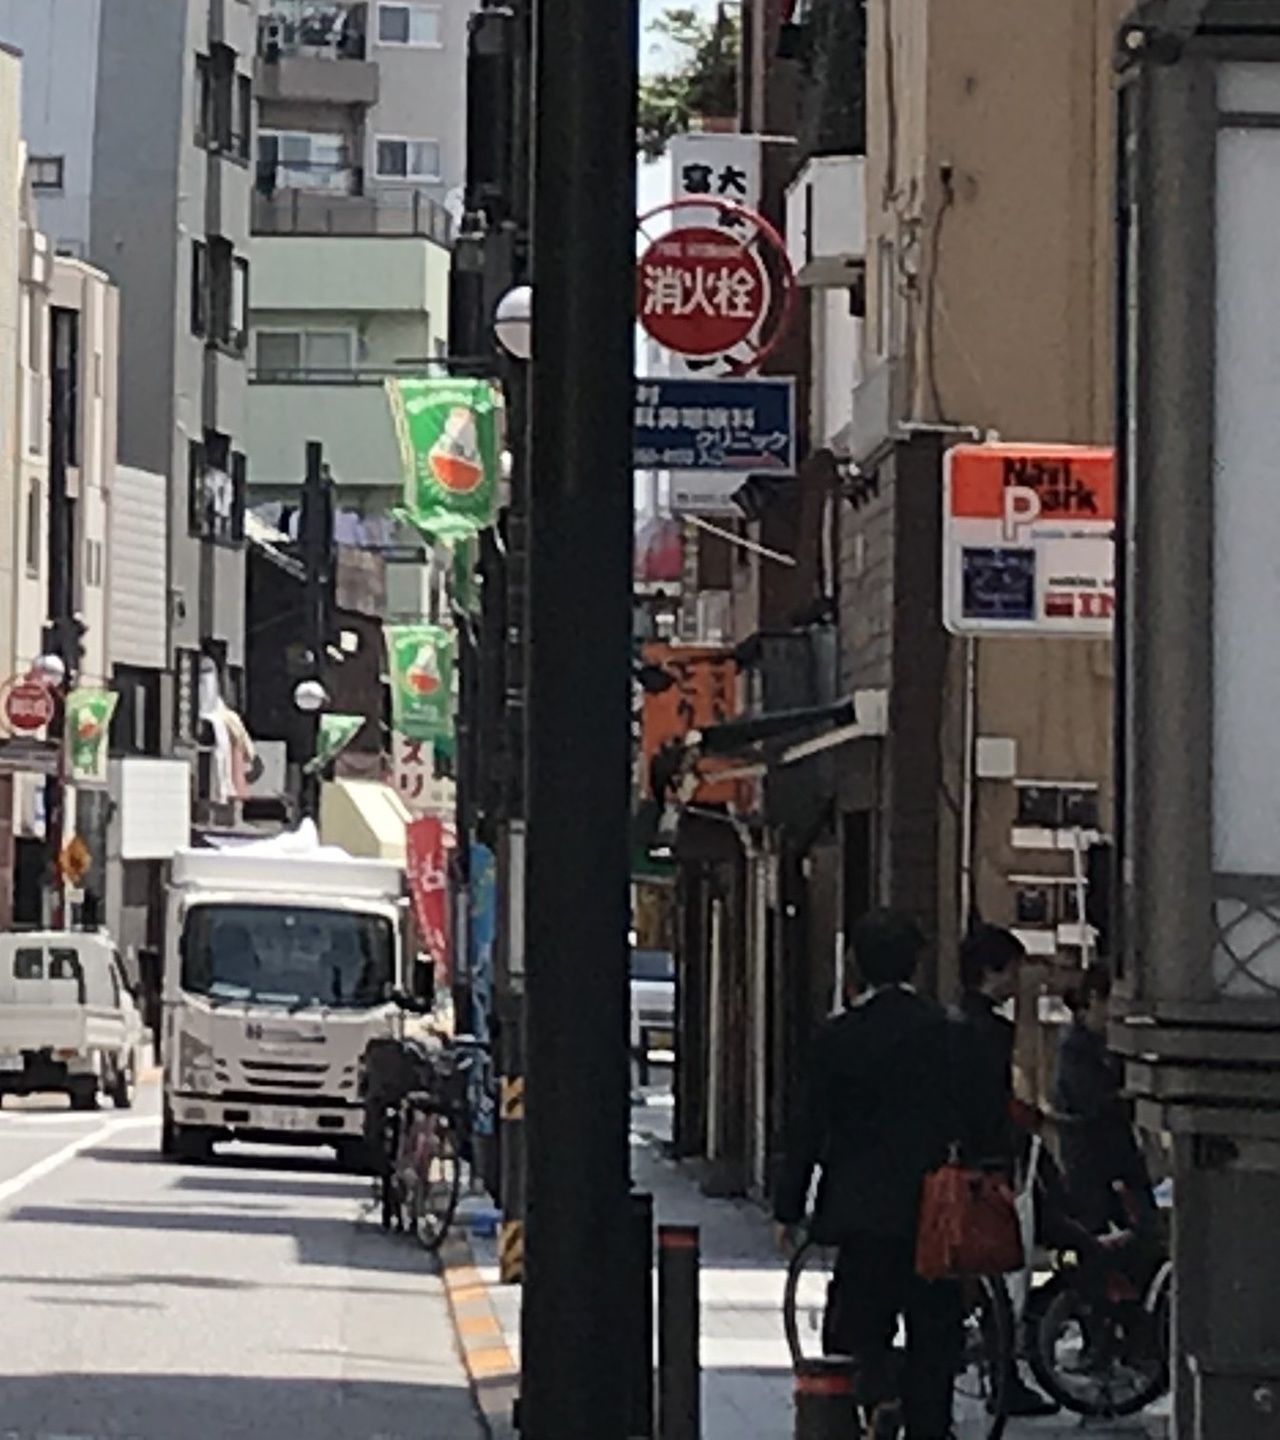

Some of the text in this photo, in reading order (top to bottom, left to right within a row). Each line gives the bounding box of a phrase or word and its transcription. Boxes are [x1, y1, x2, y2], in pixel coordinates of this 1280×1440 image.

[643, 264, 756, 318] 消火栓
[696, 430, 788, 450] クリニック
